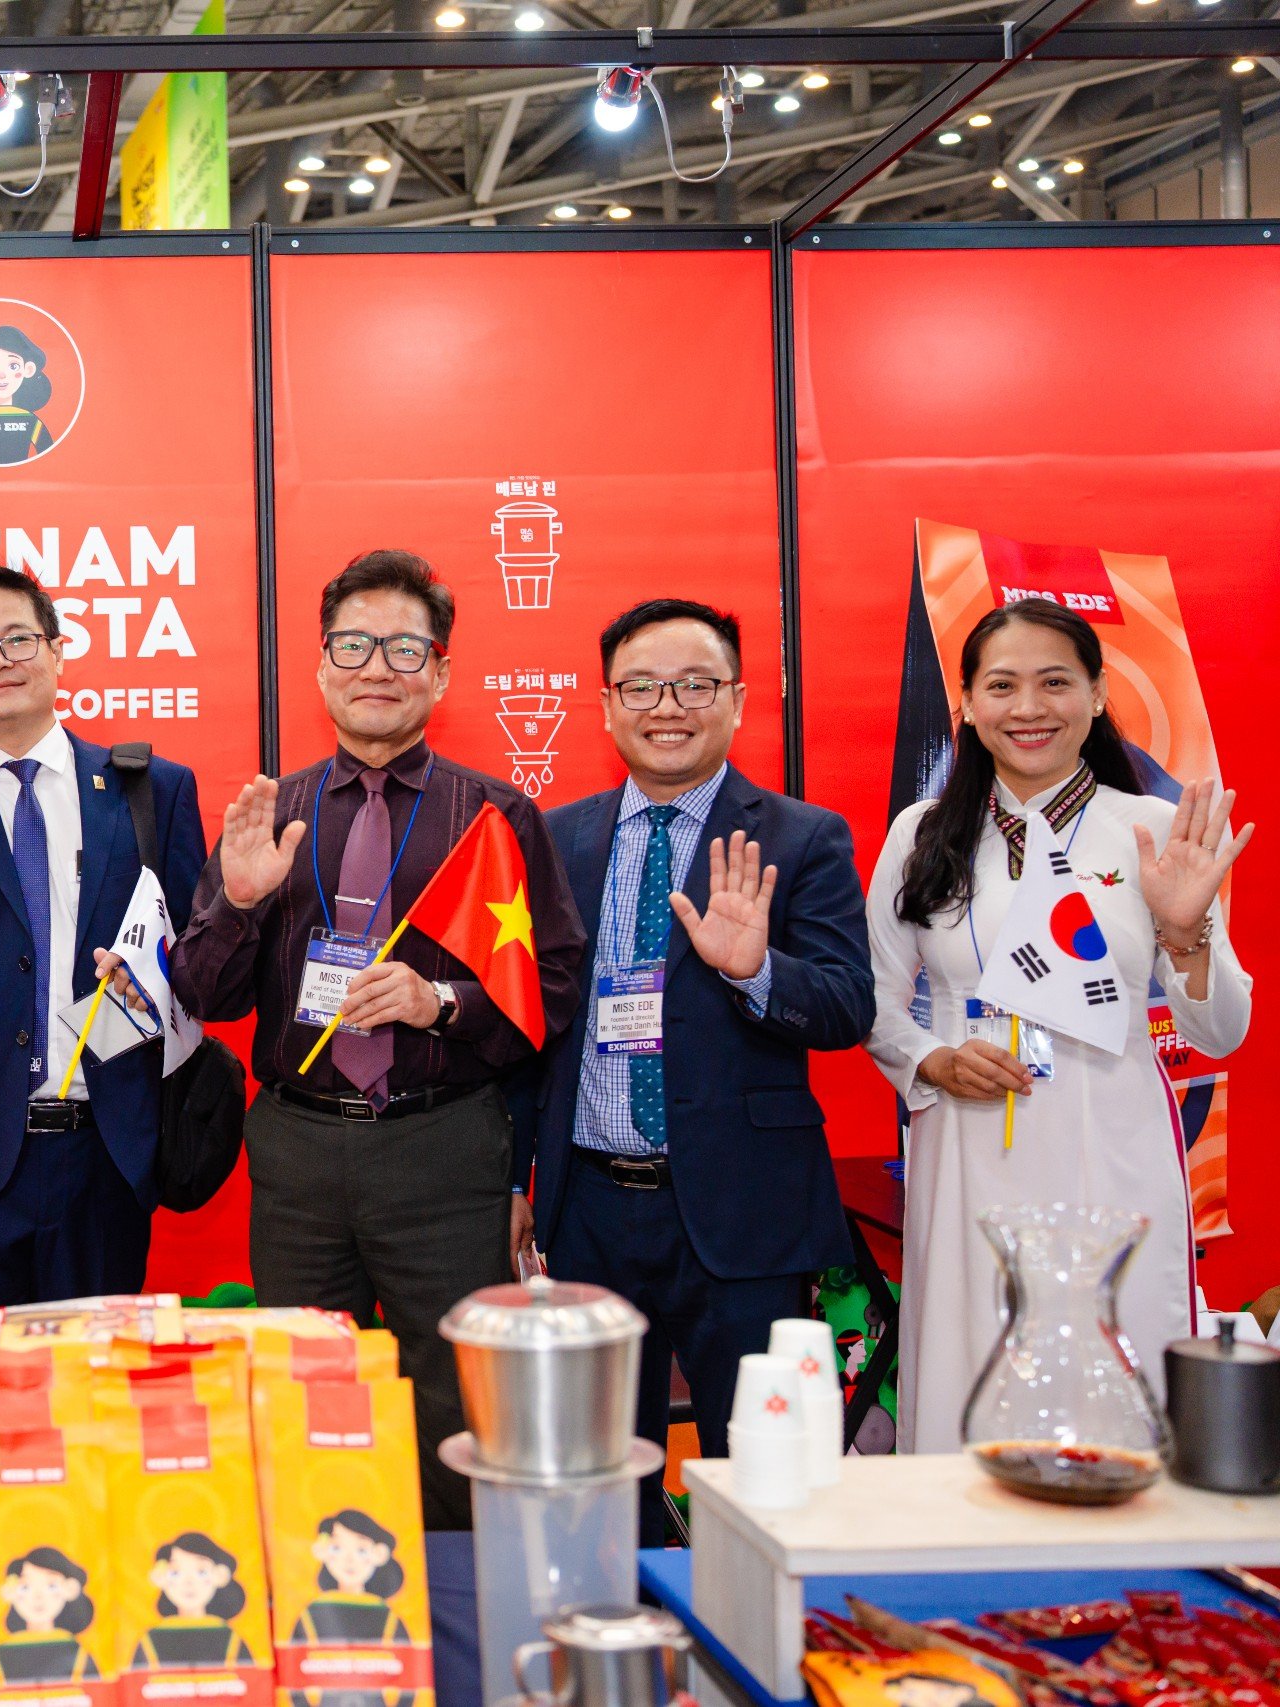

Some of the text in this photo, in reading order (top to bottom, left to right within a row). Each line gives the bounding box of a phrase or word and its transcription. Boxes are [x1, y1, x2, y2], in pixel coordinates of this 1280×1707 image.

[495, 480, 556, 497] 베트남 핀
[484, 673, 577, 690] 드립 커피 필터
[56, 688, 198, 719] COFFEE
[319, 971, 343, 985] MISS
[306, 991, 316, 999] Mr.
[612, 1000, 655, 1013] MISS EDE
[607, 1040, 657, 1052] EXHIBITOR
